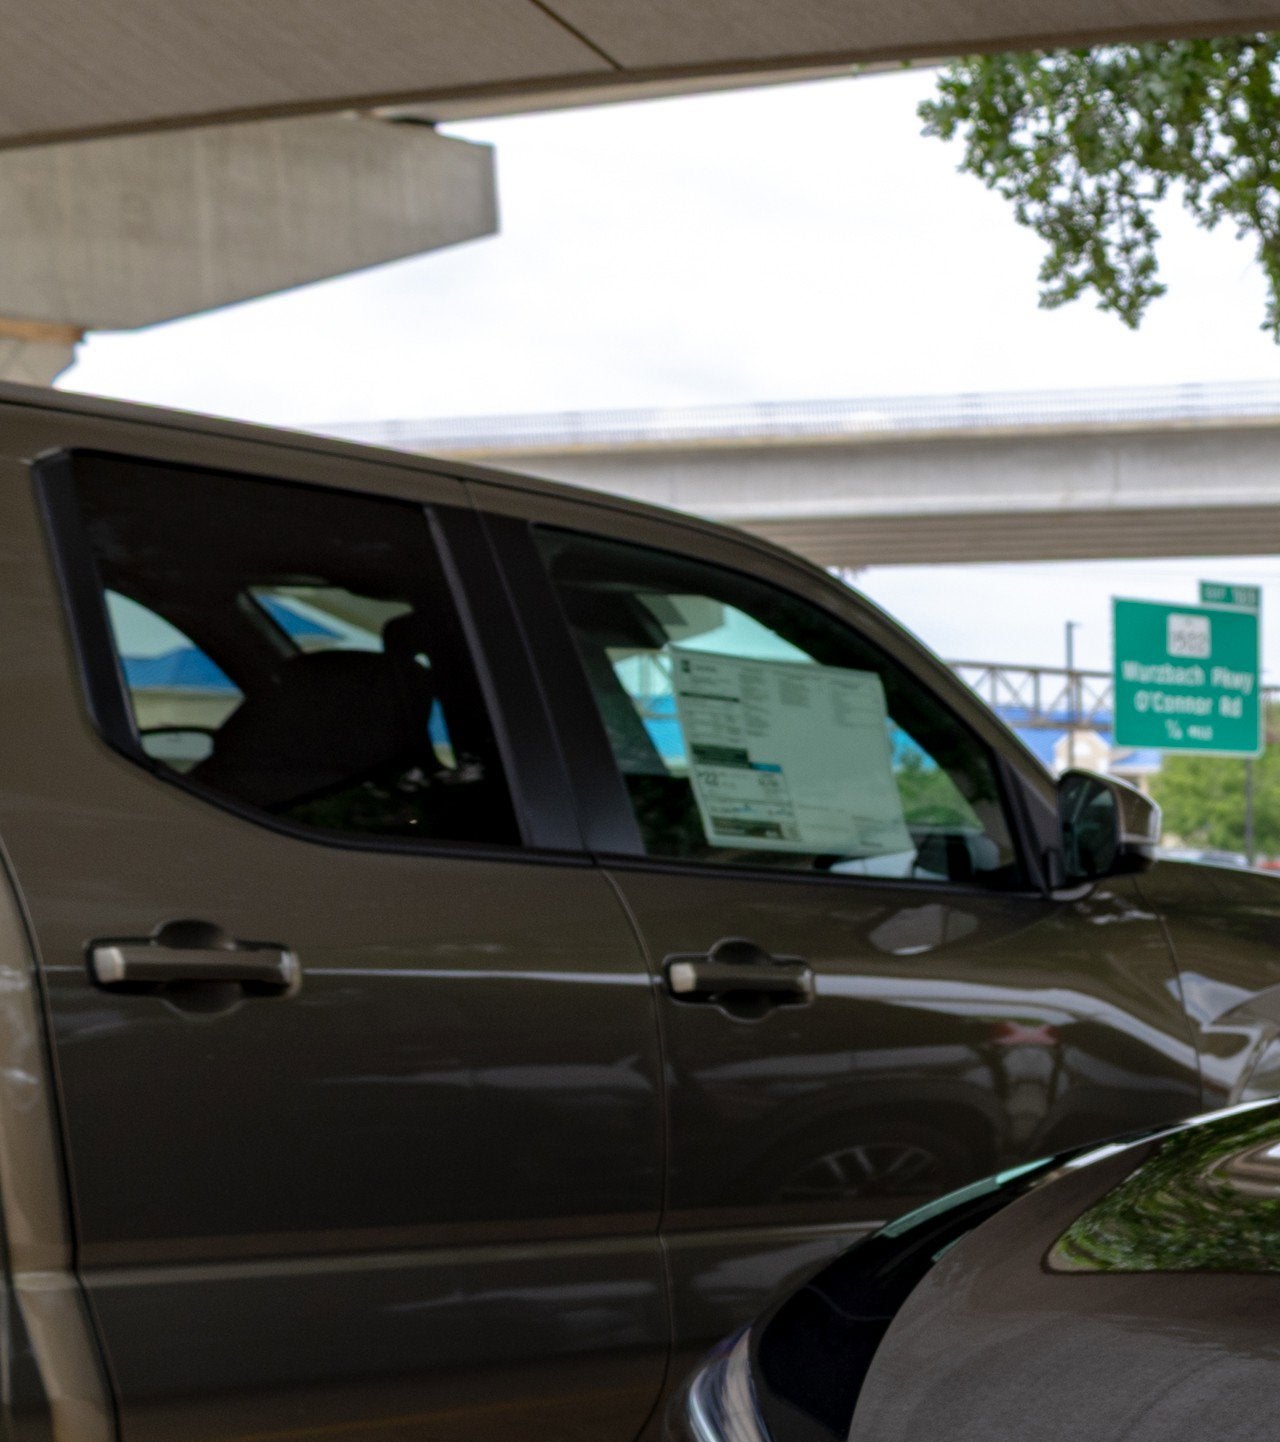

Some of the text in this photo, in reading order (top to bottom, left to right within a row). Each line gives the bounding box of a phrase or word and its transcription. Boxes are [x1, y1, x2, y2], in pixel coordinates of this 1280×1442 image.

[1121, 660, 1254, 695] Wurzbach Pkwy
[1133, 689, 1243, 718] O'Connor Rd
